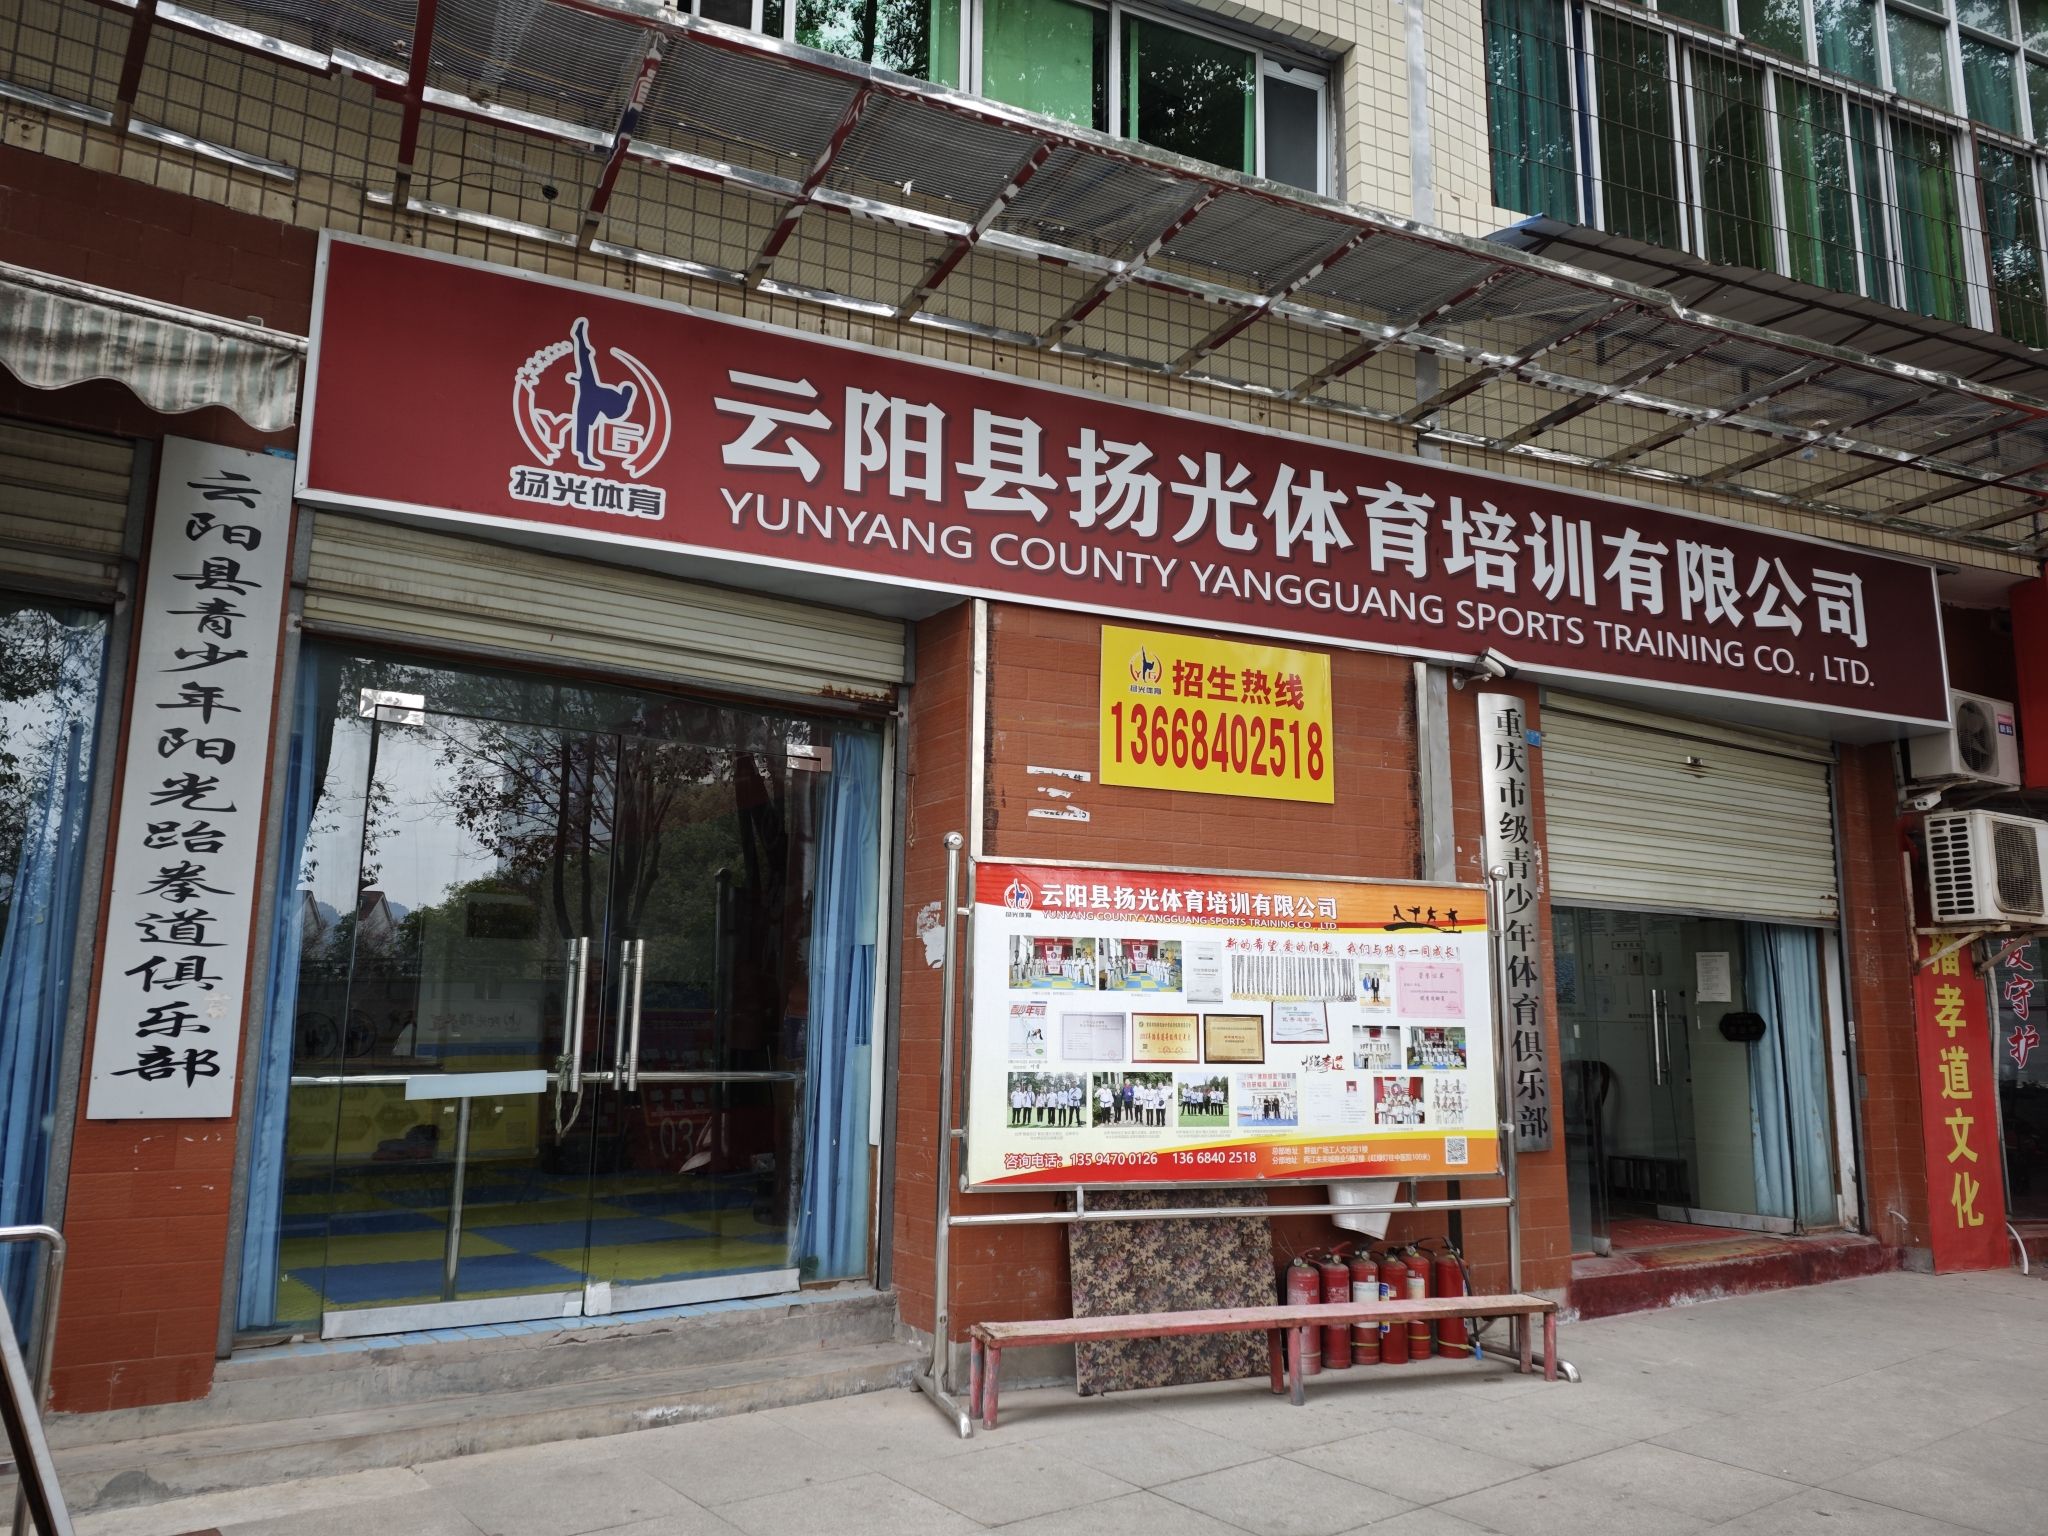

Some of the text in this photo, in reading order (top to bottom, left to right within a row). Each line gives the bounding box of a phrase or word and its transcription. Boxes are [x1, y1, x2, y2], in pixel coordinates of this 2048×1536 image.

[513, 469, 662, 516] 扬光体育
[713, 369, 1869, 649] 云阳县扬光体育培训有限公司
[719, 487, 973, 559] YUNYANG
[989, 532, 1178, 588] COUNTY
[1190, 559, 1445, 624] YANGGUANG
[1456, 600, 1585, 646] SPORTS
[1594, 621, 1745, 669] TRAINING
[1823, 655, 1875, 687] LTD.
[1172, 659, 1305, 710] 招生热线
[1111, 701, 1324, 781] 13668402518
[110, 470, 262, 1088] 云阳县青少年阳光跆拳道俱乐部
[1040, 883, 1338, 920] 云阳县扬光体育培训有限公司
[1042, 909, 1094, 921] YUNYANG
[1097, 911, 1140, 922] COUNTY
[1142, 913, 1208, 926] YANGGUANG
[1209, 916, 1247, 927] SPORTS
[1249, 917, 1294, 929] TRAINING
[1493, 707, 1550, 1138] 重庆市级青少年体育俱乐部
[1004, 1150, 1257, 1170] 咨询电话: 135 9470 0126 136 6840 2518
